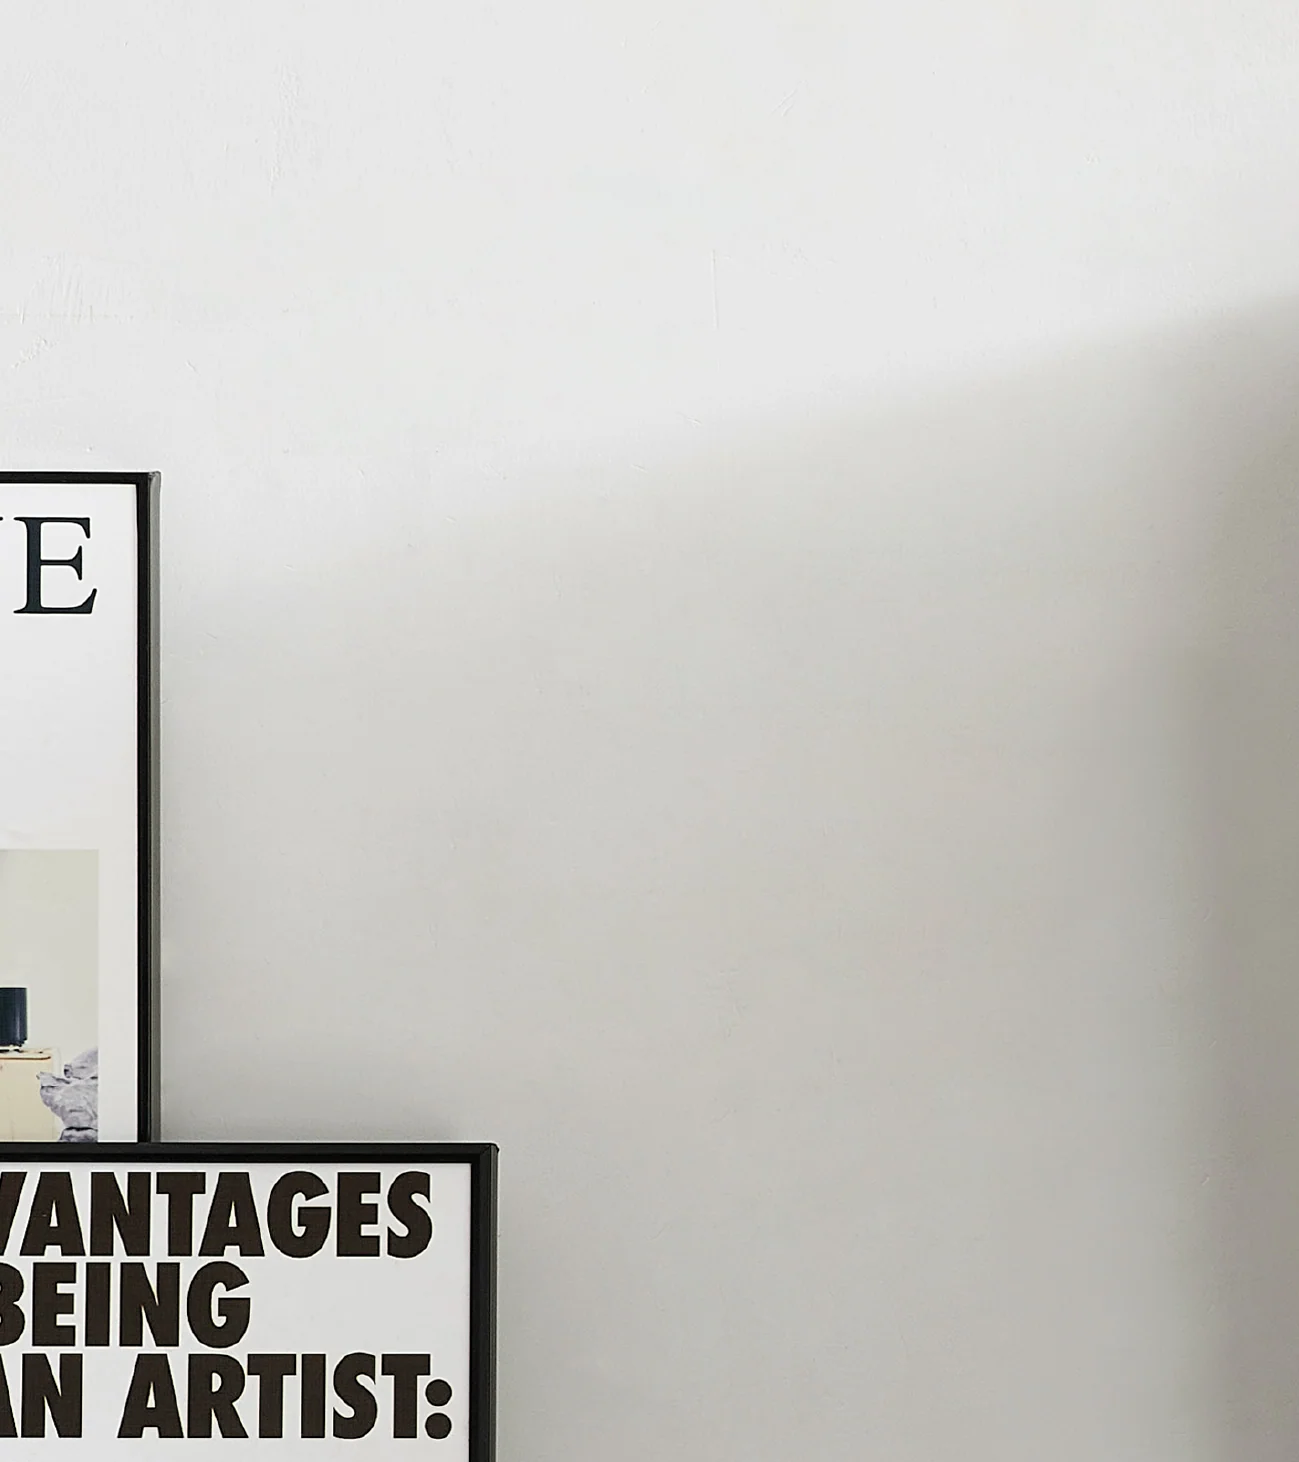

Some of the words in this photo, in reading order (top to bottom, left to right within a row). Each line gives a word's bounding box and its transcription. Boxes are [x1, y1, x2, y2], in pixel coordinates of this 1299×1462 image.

[0, 516, 98, 614] E
[0, 1353, 83, 1439] N
[117, 1351, 453, 1440] ARTIST:
